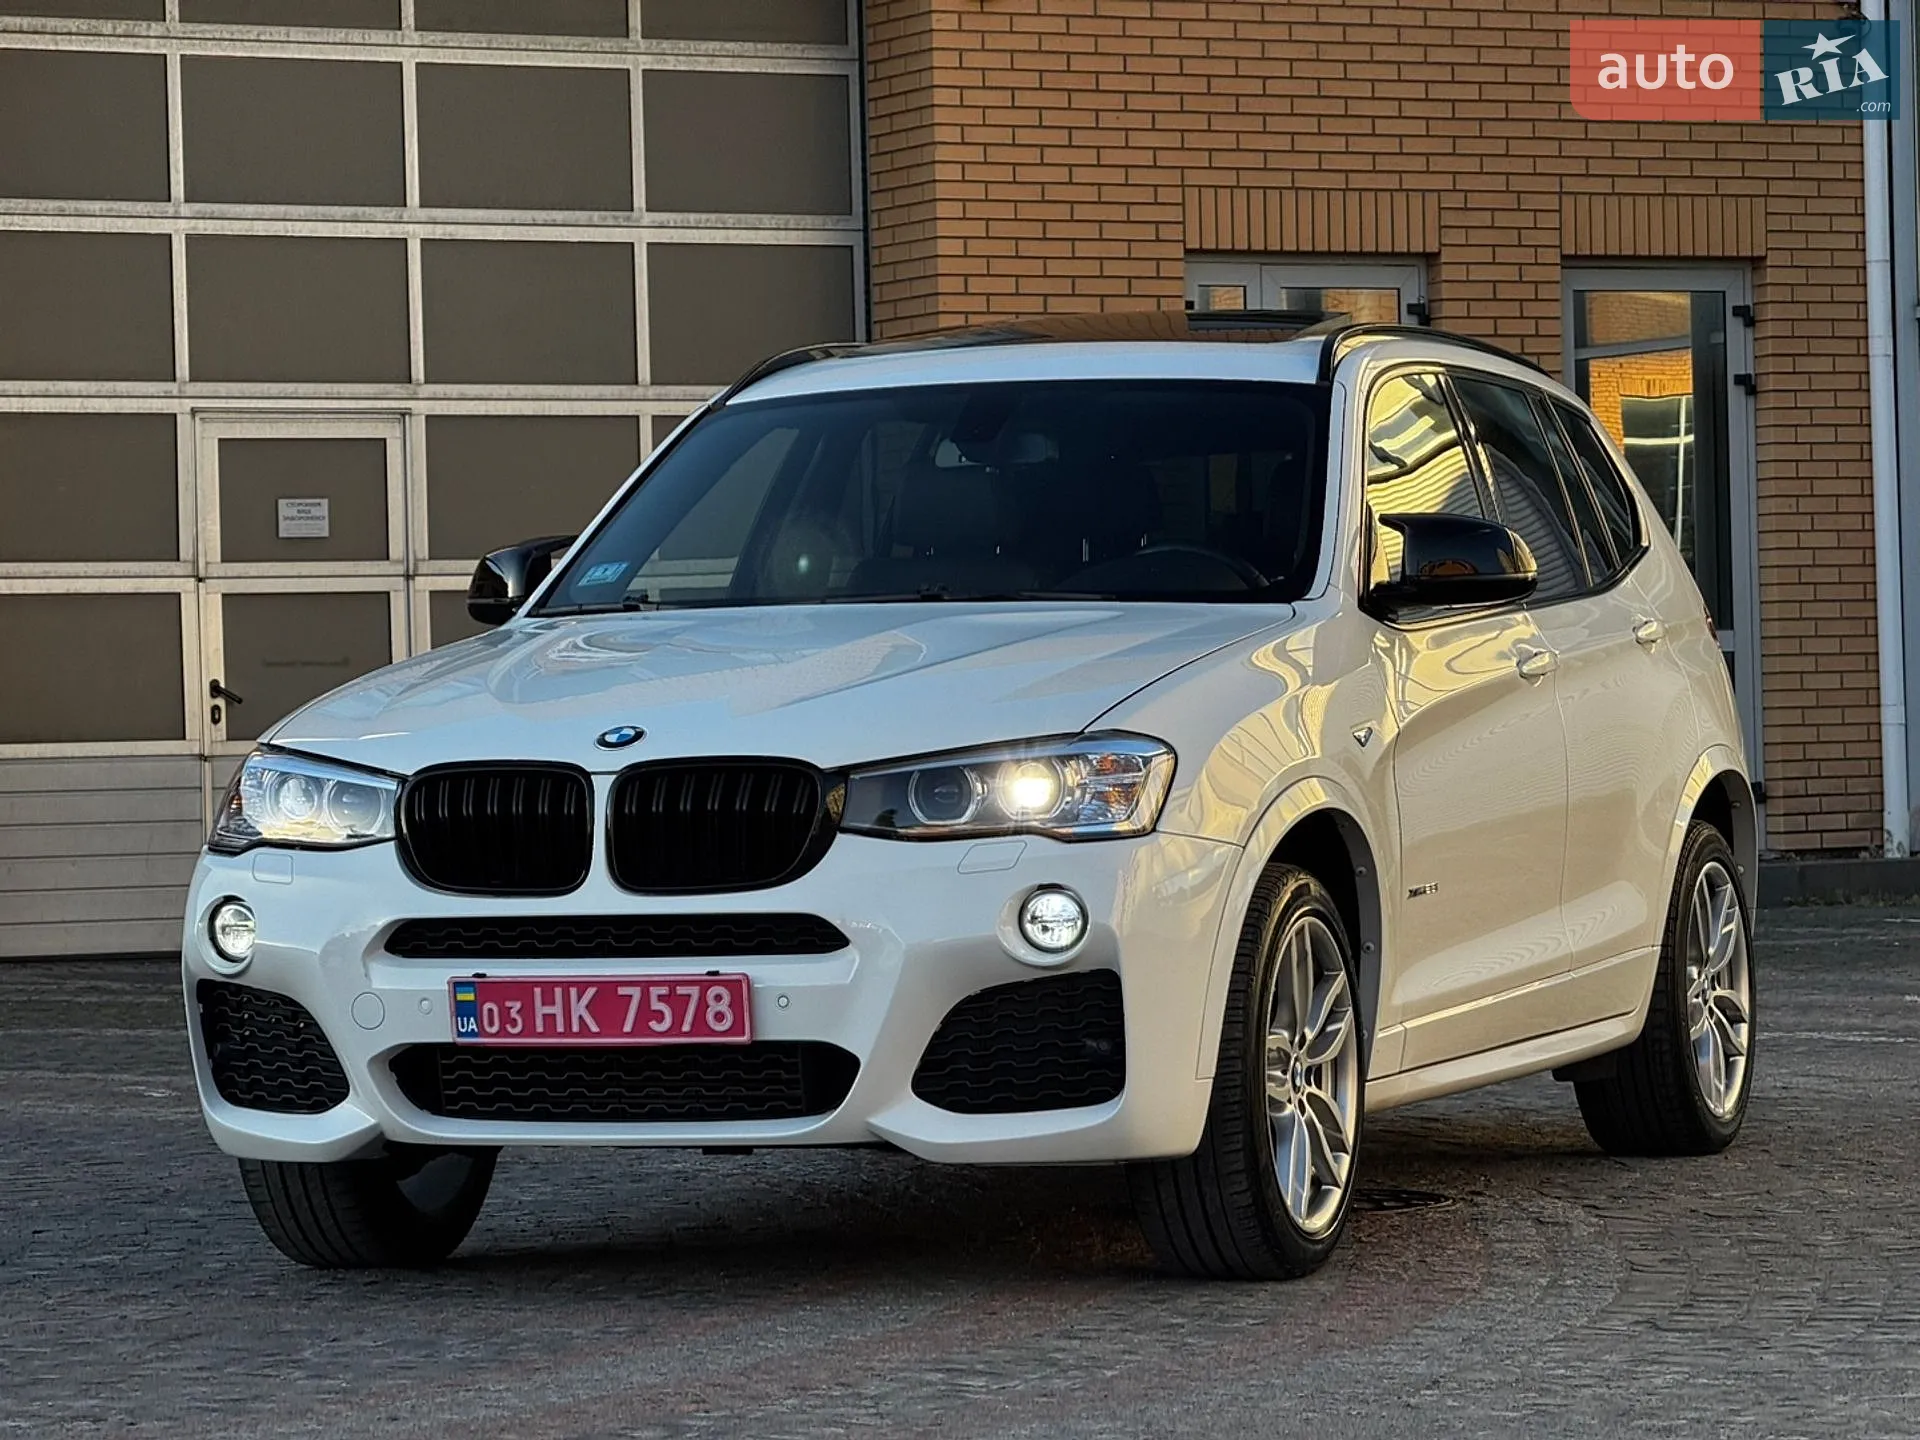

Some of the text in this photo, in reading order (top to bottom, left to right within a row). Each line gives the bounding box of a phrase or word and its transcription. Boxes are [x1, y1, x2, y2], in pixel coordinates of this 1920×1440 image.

[456, 1015, 479, 1034] UA
[482, 984, 735, 1035] 03 HK 7578
